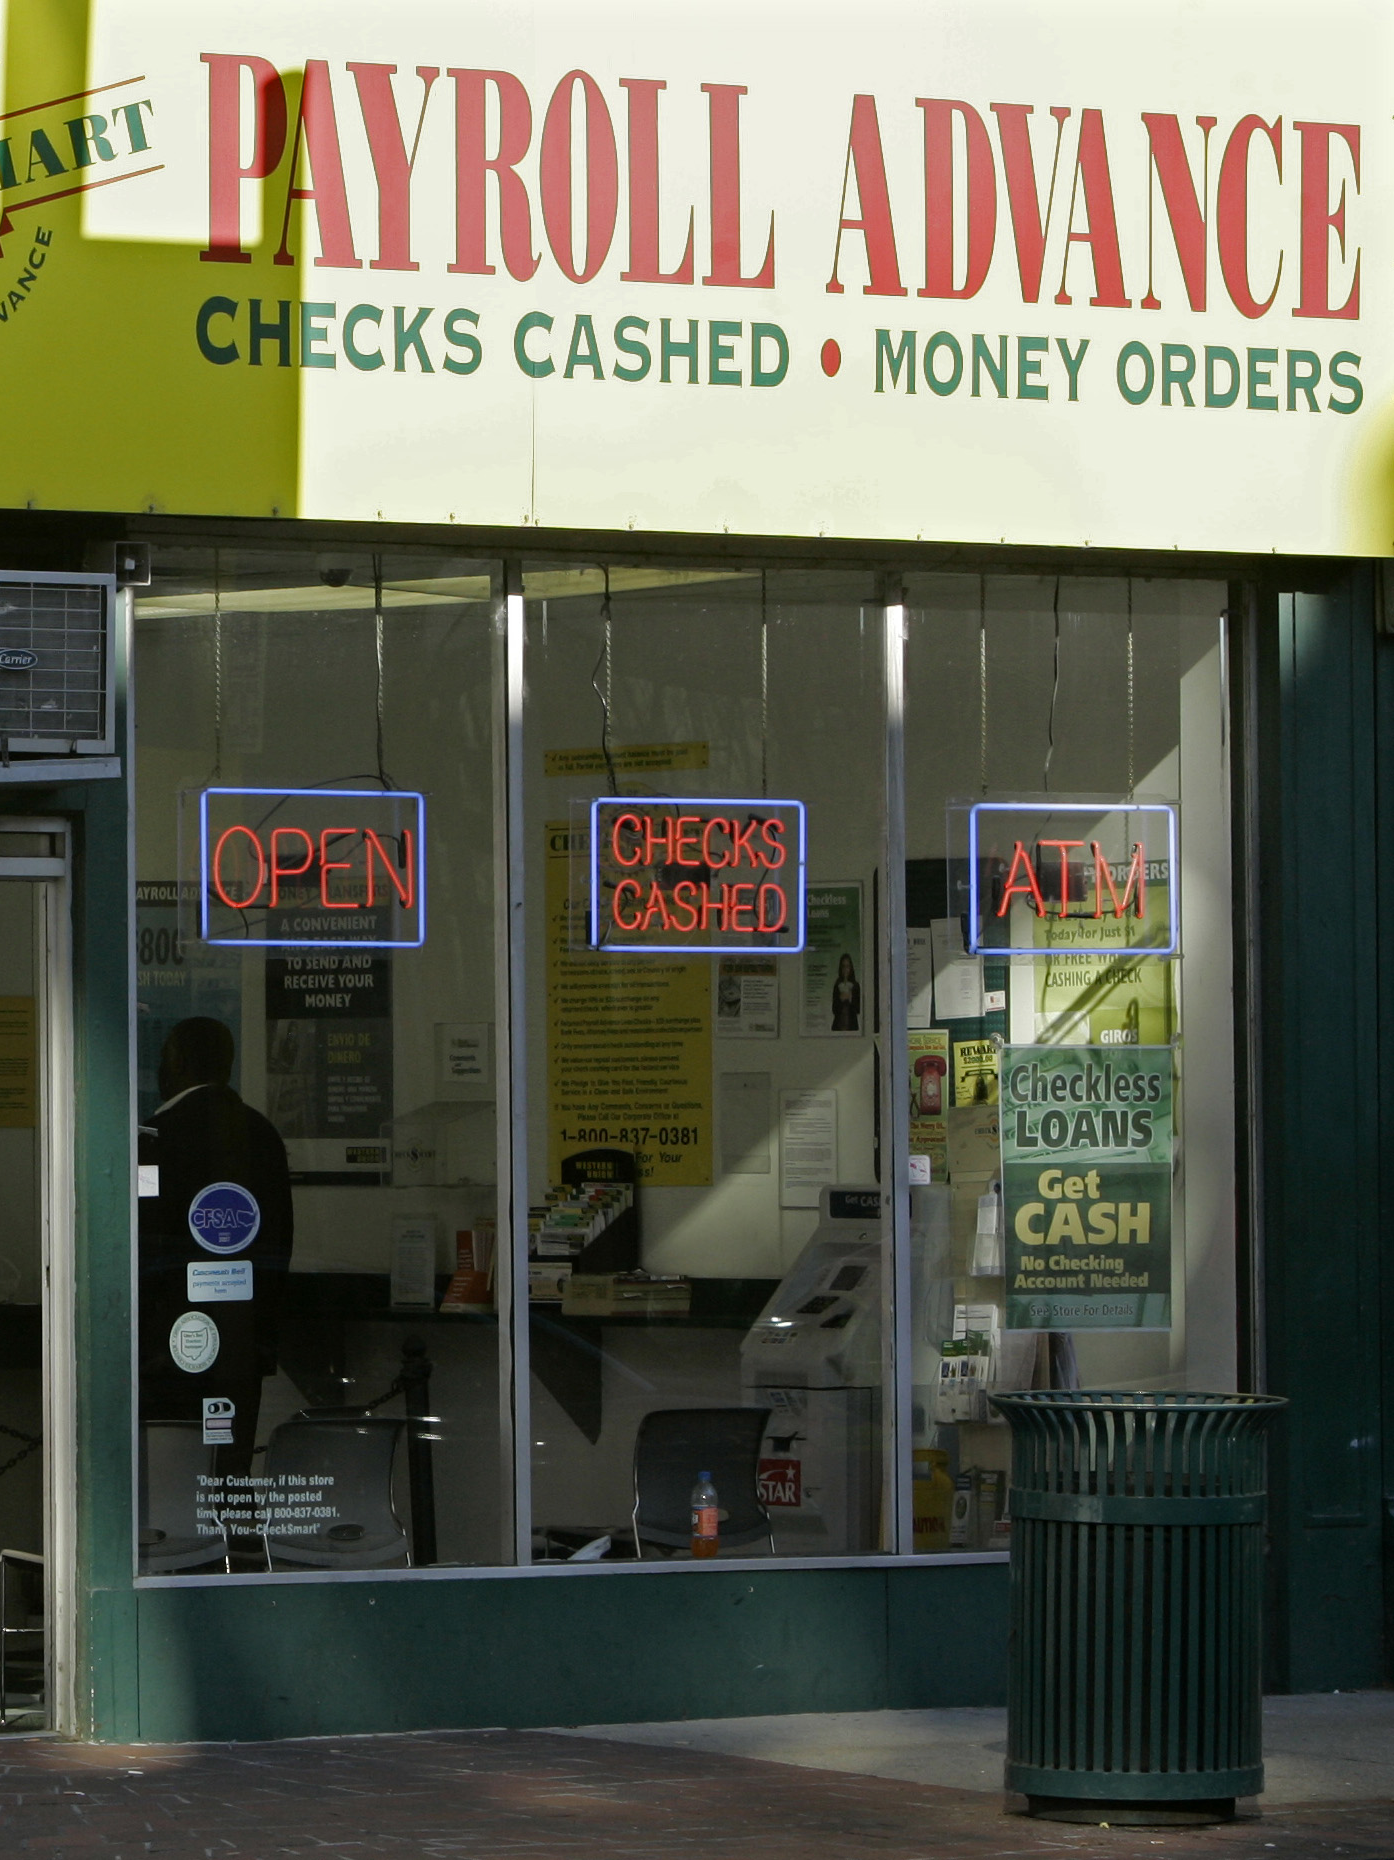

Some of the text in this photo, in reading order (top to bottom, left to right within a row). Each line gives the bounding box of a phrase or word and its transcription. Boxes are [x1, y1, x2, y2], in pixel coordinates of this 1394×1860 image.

[199, 52, 1361, 320] PAYROLL ADVANCE
[196, 295, 1365, 415] CHECKS CASHED MONEY ORDERS
[612, 813, 788, 870] CHECKS
[213, 825, 415, 909] OPEN
[997, 840, 1144, 919] ATM
[136, 886, 178, 900] AYROLL
[612, 879, 789, 933] CASHED
[280, 915, 377, 931] A CONVENIENT
[136, 928, 184, 965] 800
[286, 955, 372, 970] TO SEND AND
[284, 974, 374, 989] RECEIVE YOUR
[1045, 969, 1091, 988] CASHING
[305, 994, 352, 1008] MONEY
[960, 1045, 1000, 1057] REWAR
[1010, 1062, 1161, 1103] Checkless
[561, 1127, 698, 1145] 1-800-837-0381
[1014, 1109, 1153, 1150] LOANS
[659, 1152, 683, 1163] Your
[1037, 1169, 1101, 1199] Get
[860, 1195, 881, 1207] CAS
[191, 1208, 238, 1229] CFSA
[1014, 1202, 1151, 1245] CASH
[1020, 1255, 1124, 1273] No Checking
[1014, 1272, 1149, 1289] Account Needed
[1030, 1302, 1134, 1317] See Store For Details
[226, 1475, 276, 1488] Customer,
[278, 1474, 286, 1486] if
[288, 1474, 307, 1486] this
[309, 1474, 334, 1486] store
[196, 1490, 322, 1505] is not open by the posted
[758, 1481, 797, 1503] STAR
[196, 1507, 219, 1519] time
[220, 1507, 252, 1521] please
[254, 1507, 272, 1519] call
[196, 1523, 227, 1535] Thank
